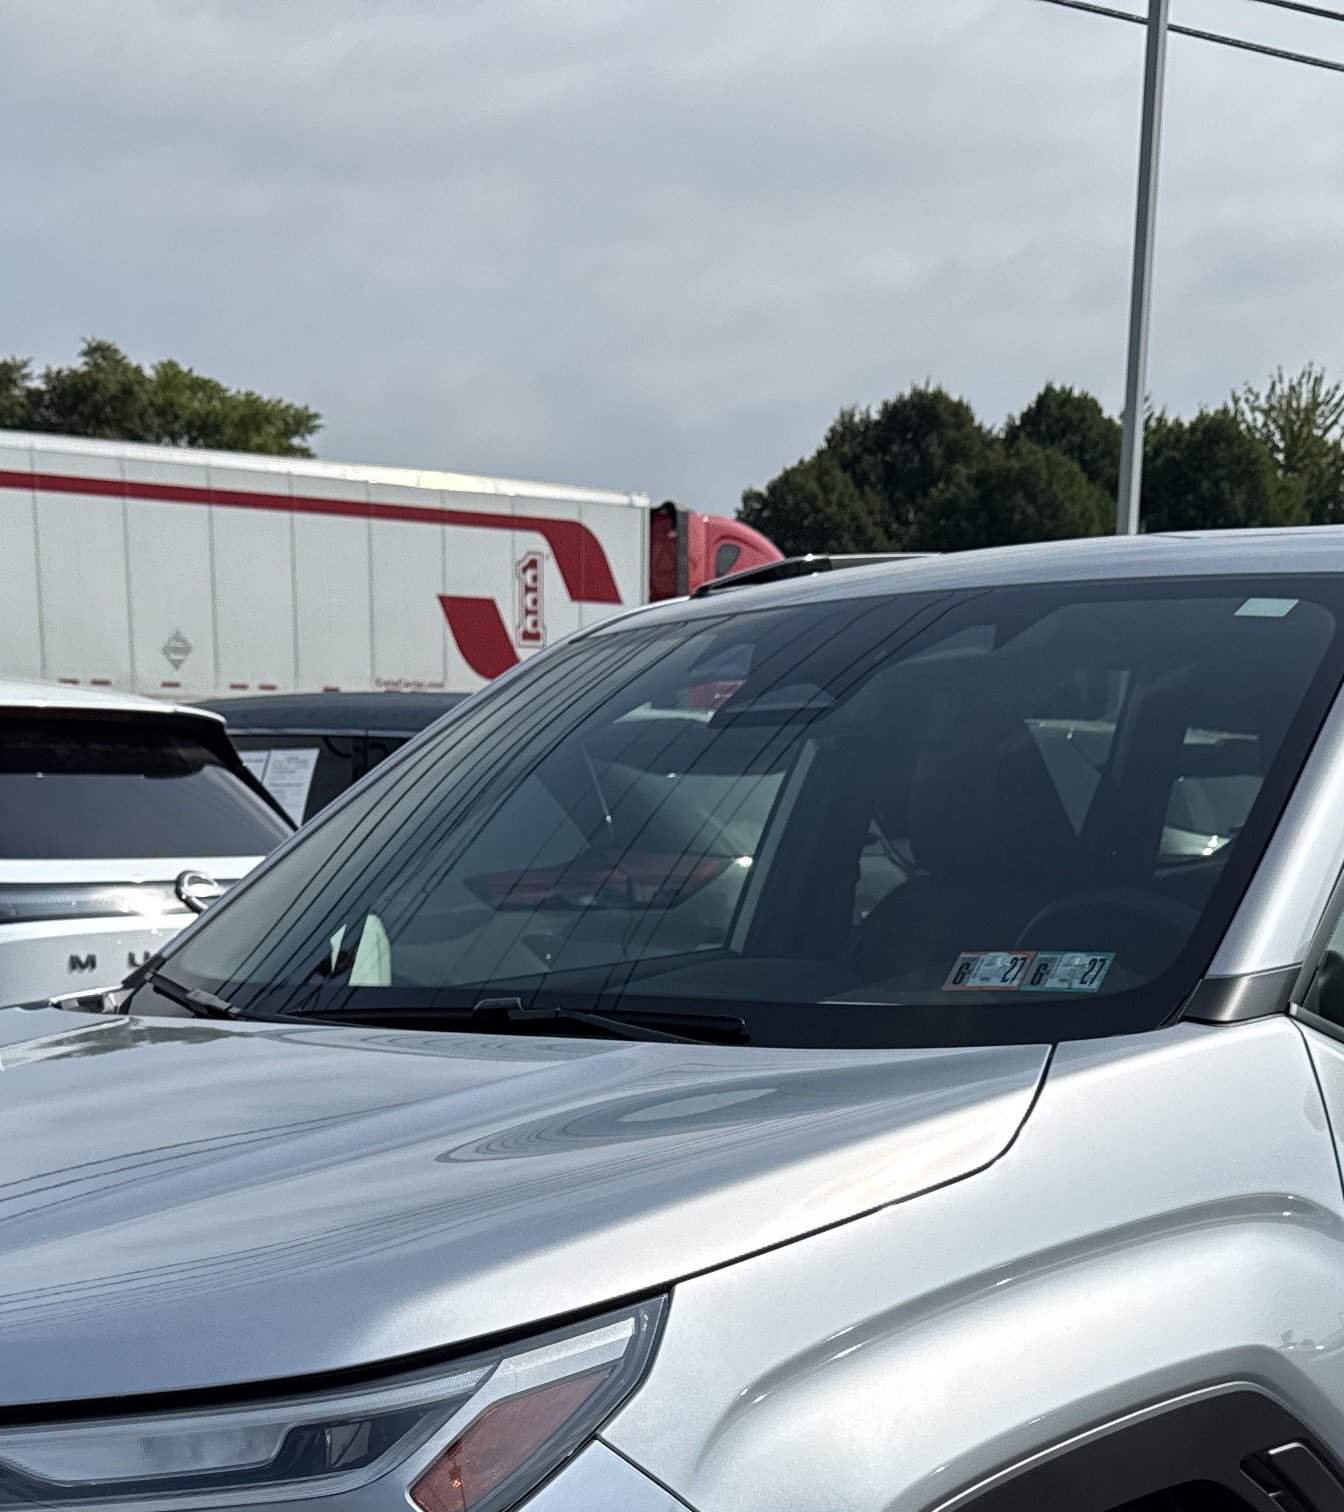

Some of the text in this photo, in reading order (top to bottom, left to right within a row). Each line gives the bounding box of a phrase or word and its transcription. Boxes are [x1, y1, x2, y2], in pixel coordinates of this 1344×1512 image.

[952, 957, 1027, 985] 6 27
[1030, 958, 1107, 986] 6 27
